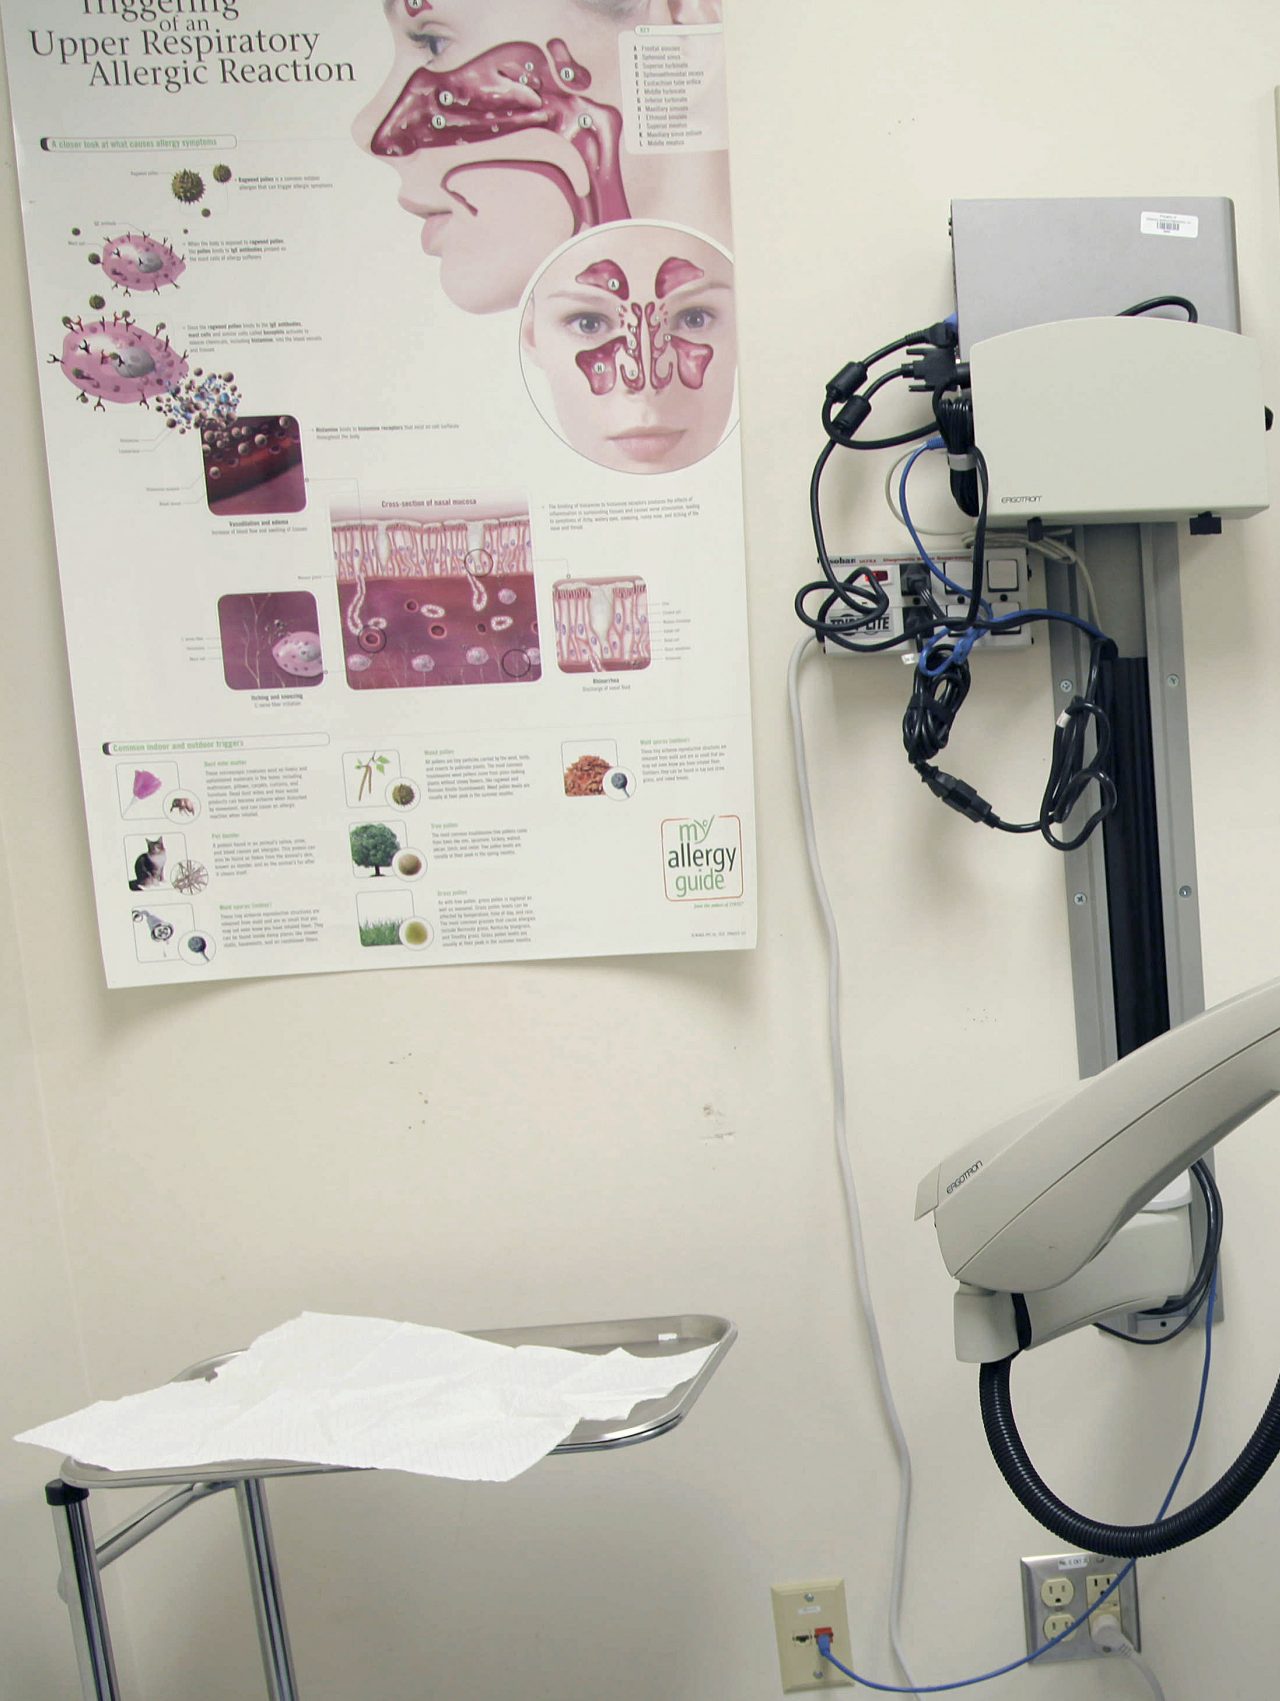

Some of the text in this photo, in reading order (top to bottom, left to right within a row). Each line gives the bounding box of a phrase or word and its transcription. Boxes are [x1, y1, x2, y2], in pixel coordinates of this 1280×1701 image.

[160, 15, 209, 31] of an
[29, 28, 320, 64] Upper Respiratory
[89, 58, 356, 93] Allergic Reaction
[111, 139, 128, 148] what
[156, 139, 180, 148] allergy
[181, 138, 217, 148] symptoms
[1001, 495, 1042, 504] ERGOTRON
[668, 842, 737, 872] allergy
[675, 868, 725, 898] guide
[946, 1160, 983, 1195] ERGOTRON
